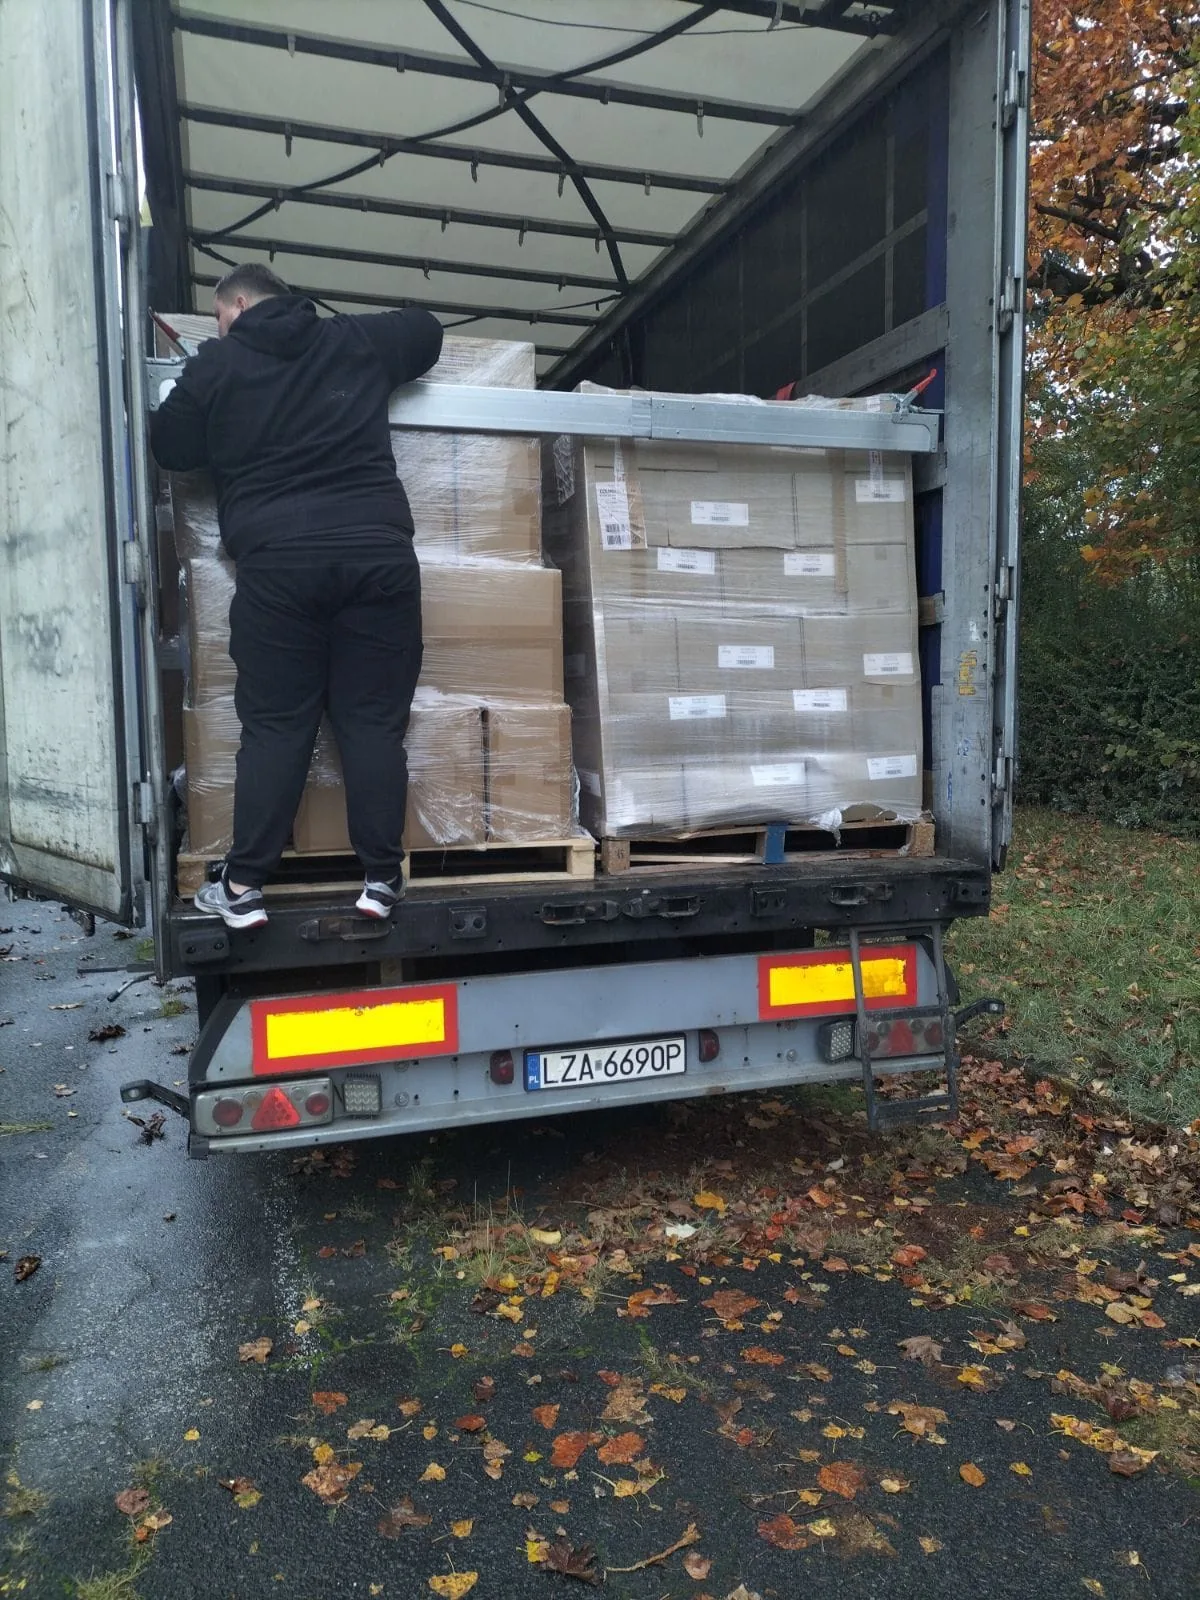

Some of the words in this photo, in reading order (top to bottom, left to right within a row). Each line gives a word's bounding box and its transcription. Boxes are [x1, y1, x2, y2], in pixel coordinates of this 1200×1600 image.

[543, 1053, 594, 1084] LZA
[604, 1044, 681, 1077] 6690P
[529, 1075, 539, 1083] PL
